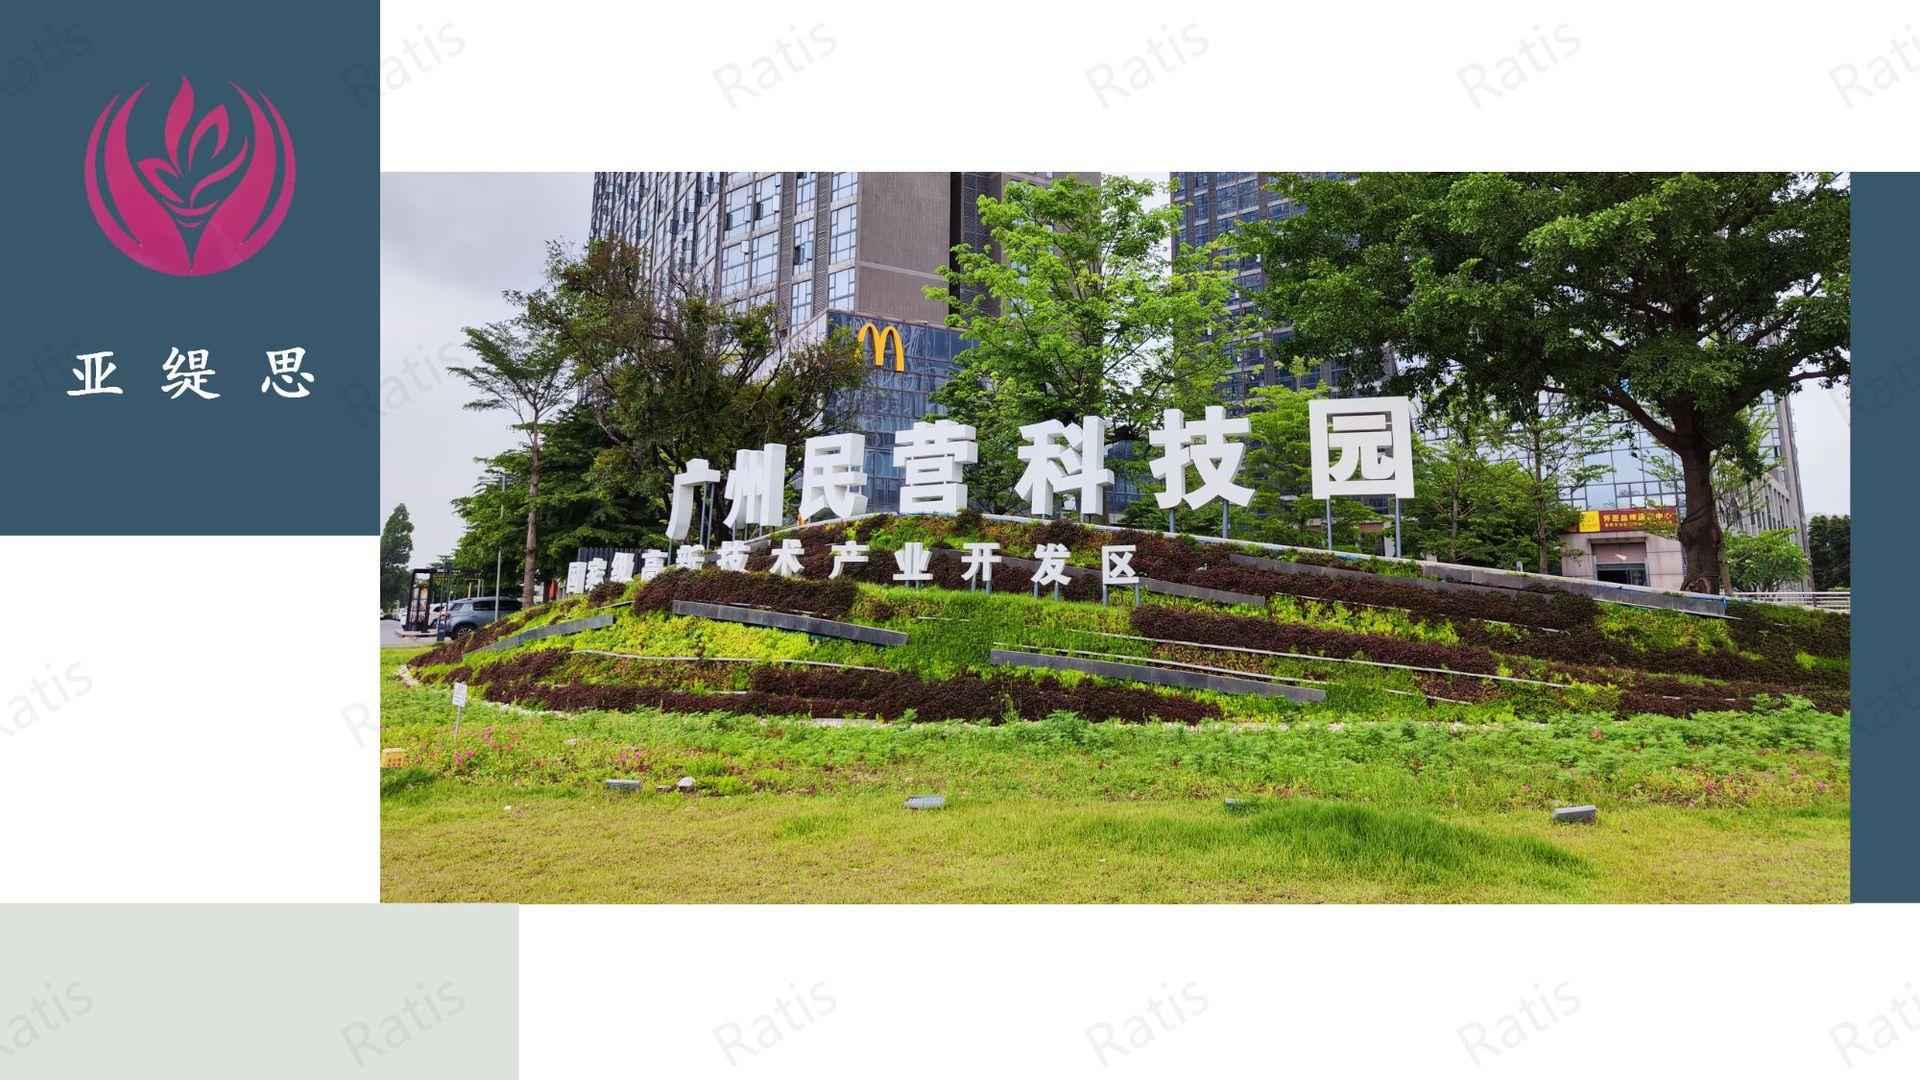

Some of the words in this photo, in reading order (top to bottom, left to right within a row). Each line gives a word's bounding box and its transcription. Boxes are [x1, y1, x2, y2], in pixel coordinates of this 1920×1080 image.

[665, 396, 1415, 541] 广州民营科技园
[566, 538, 1140, 594] 国家级高新技术产业开发区
